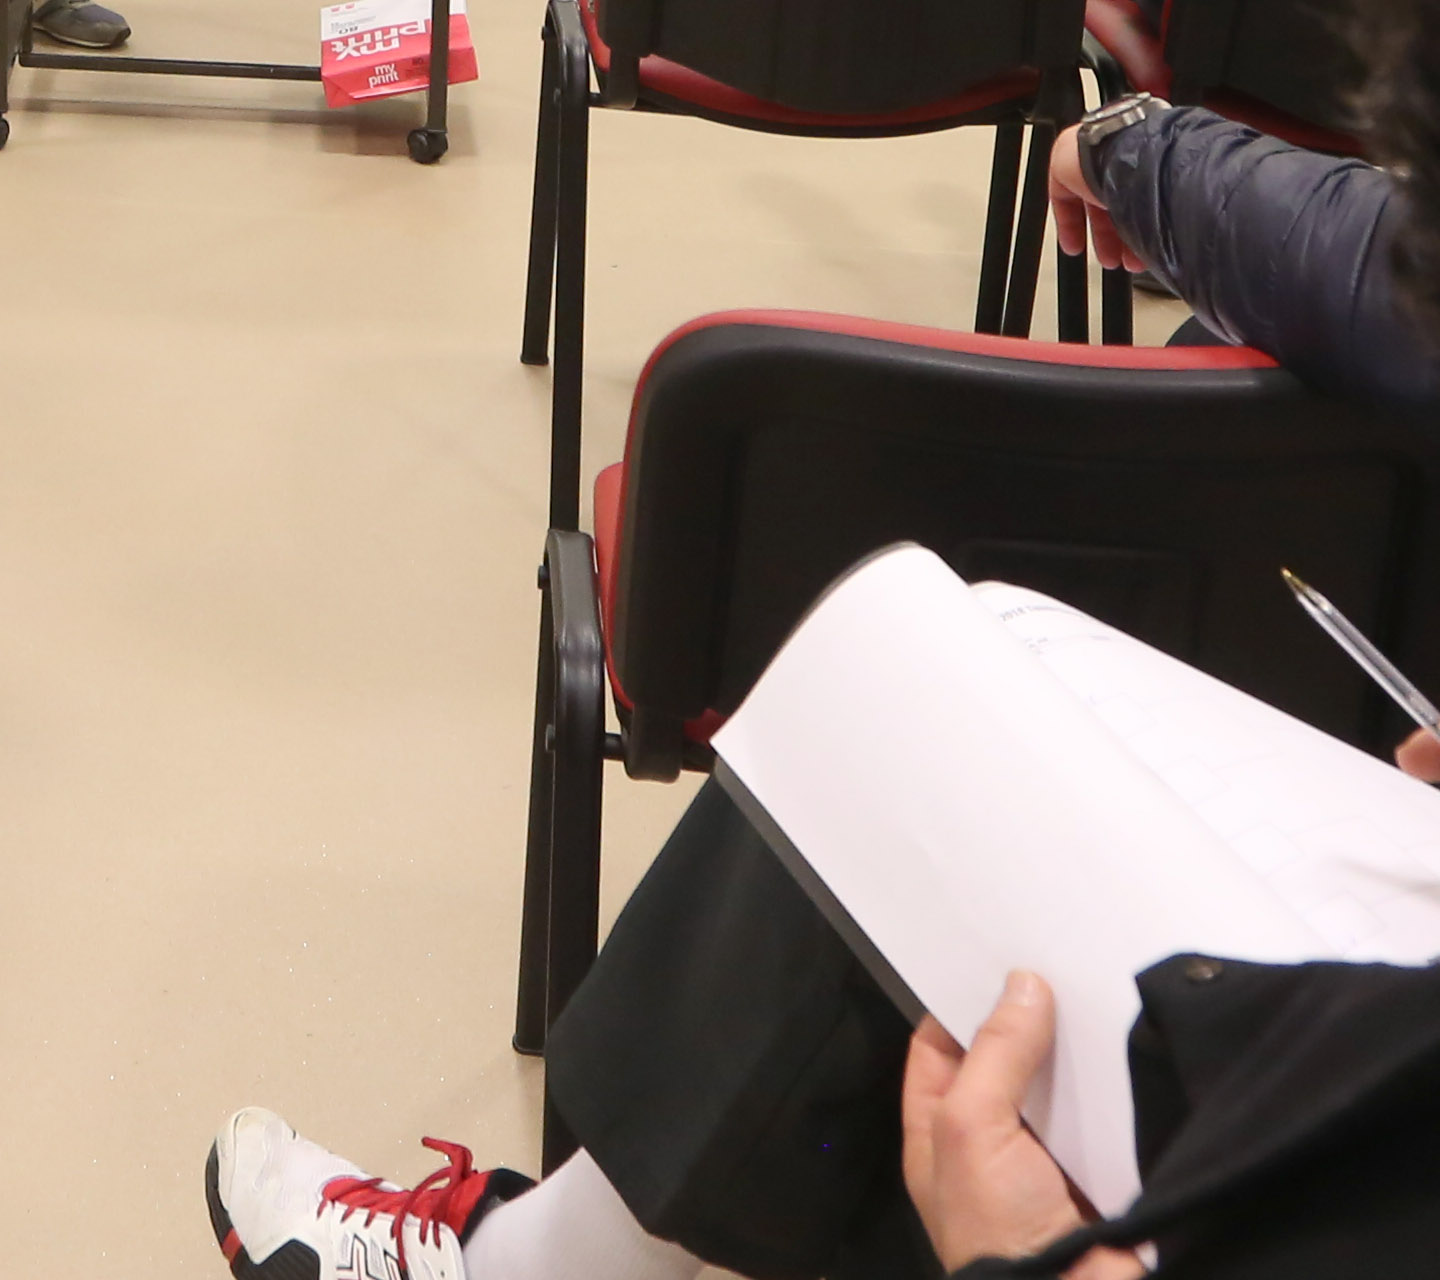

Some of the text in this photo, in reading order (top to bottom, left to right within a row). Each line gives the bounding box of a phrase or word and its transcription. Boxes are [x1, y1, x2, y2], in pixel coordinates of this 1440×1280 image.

[331, 19, 427, 52] print
[335, 36, 400, 61] my
[368, 70, 400, 89] print
[374, 63, 396, 77] my
